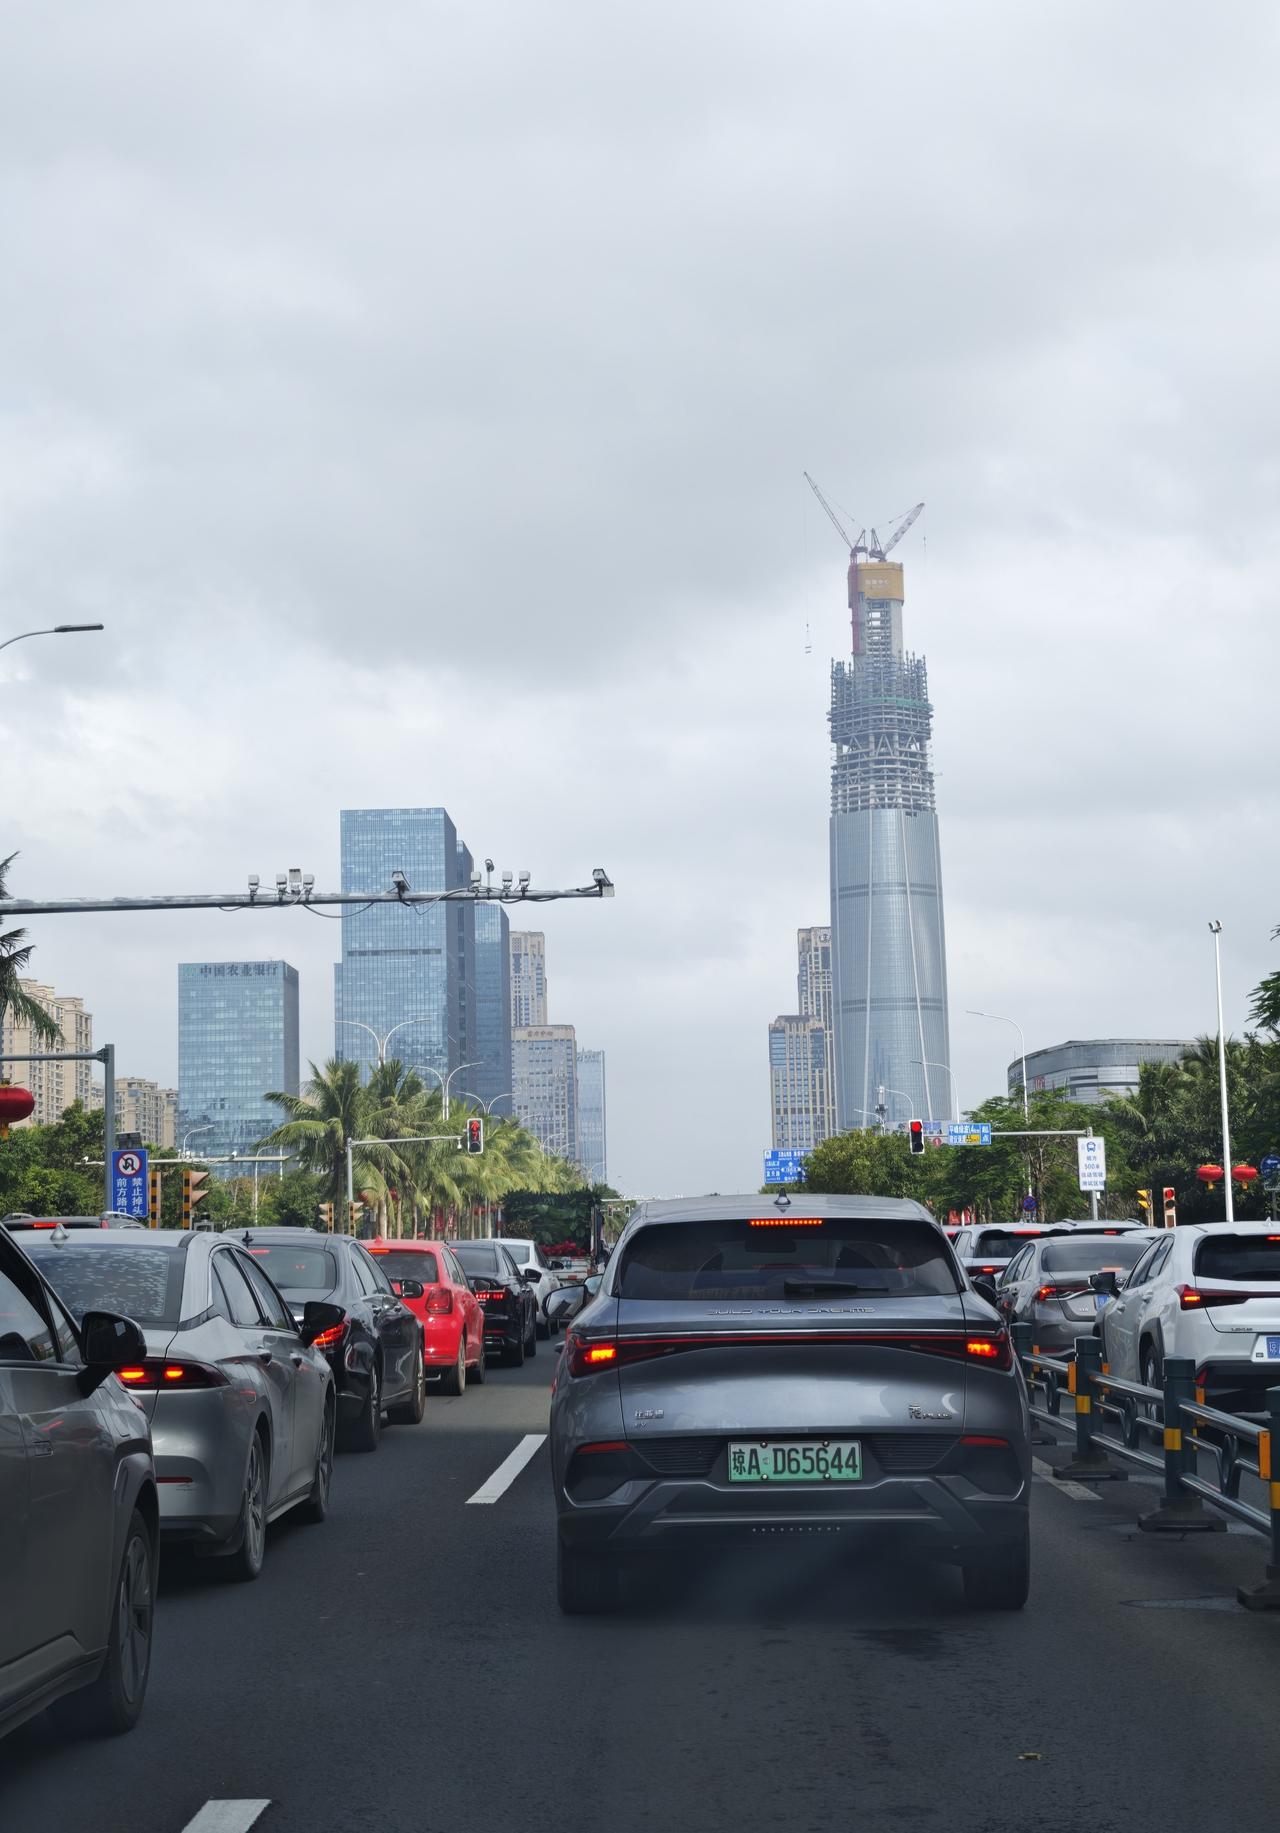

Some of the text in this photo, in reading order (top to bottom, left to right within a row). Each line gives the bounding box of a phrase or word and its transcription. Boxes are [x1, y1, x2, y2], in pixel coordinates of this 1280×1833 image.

[200, 964, 278, 978] 中国农业银行
[116, 1178, 128, 1214] 前方路口
[131, 1177, 143, 1216] 禁止掉头
[773, 1446, 858, 1475] D65644
